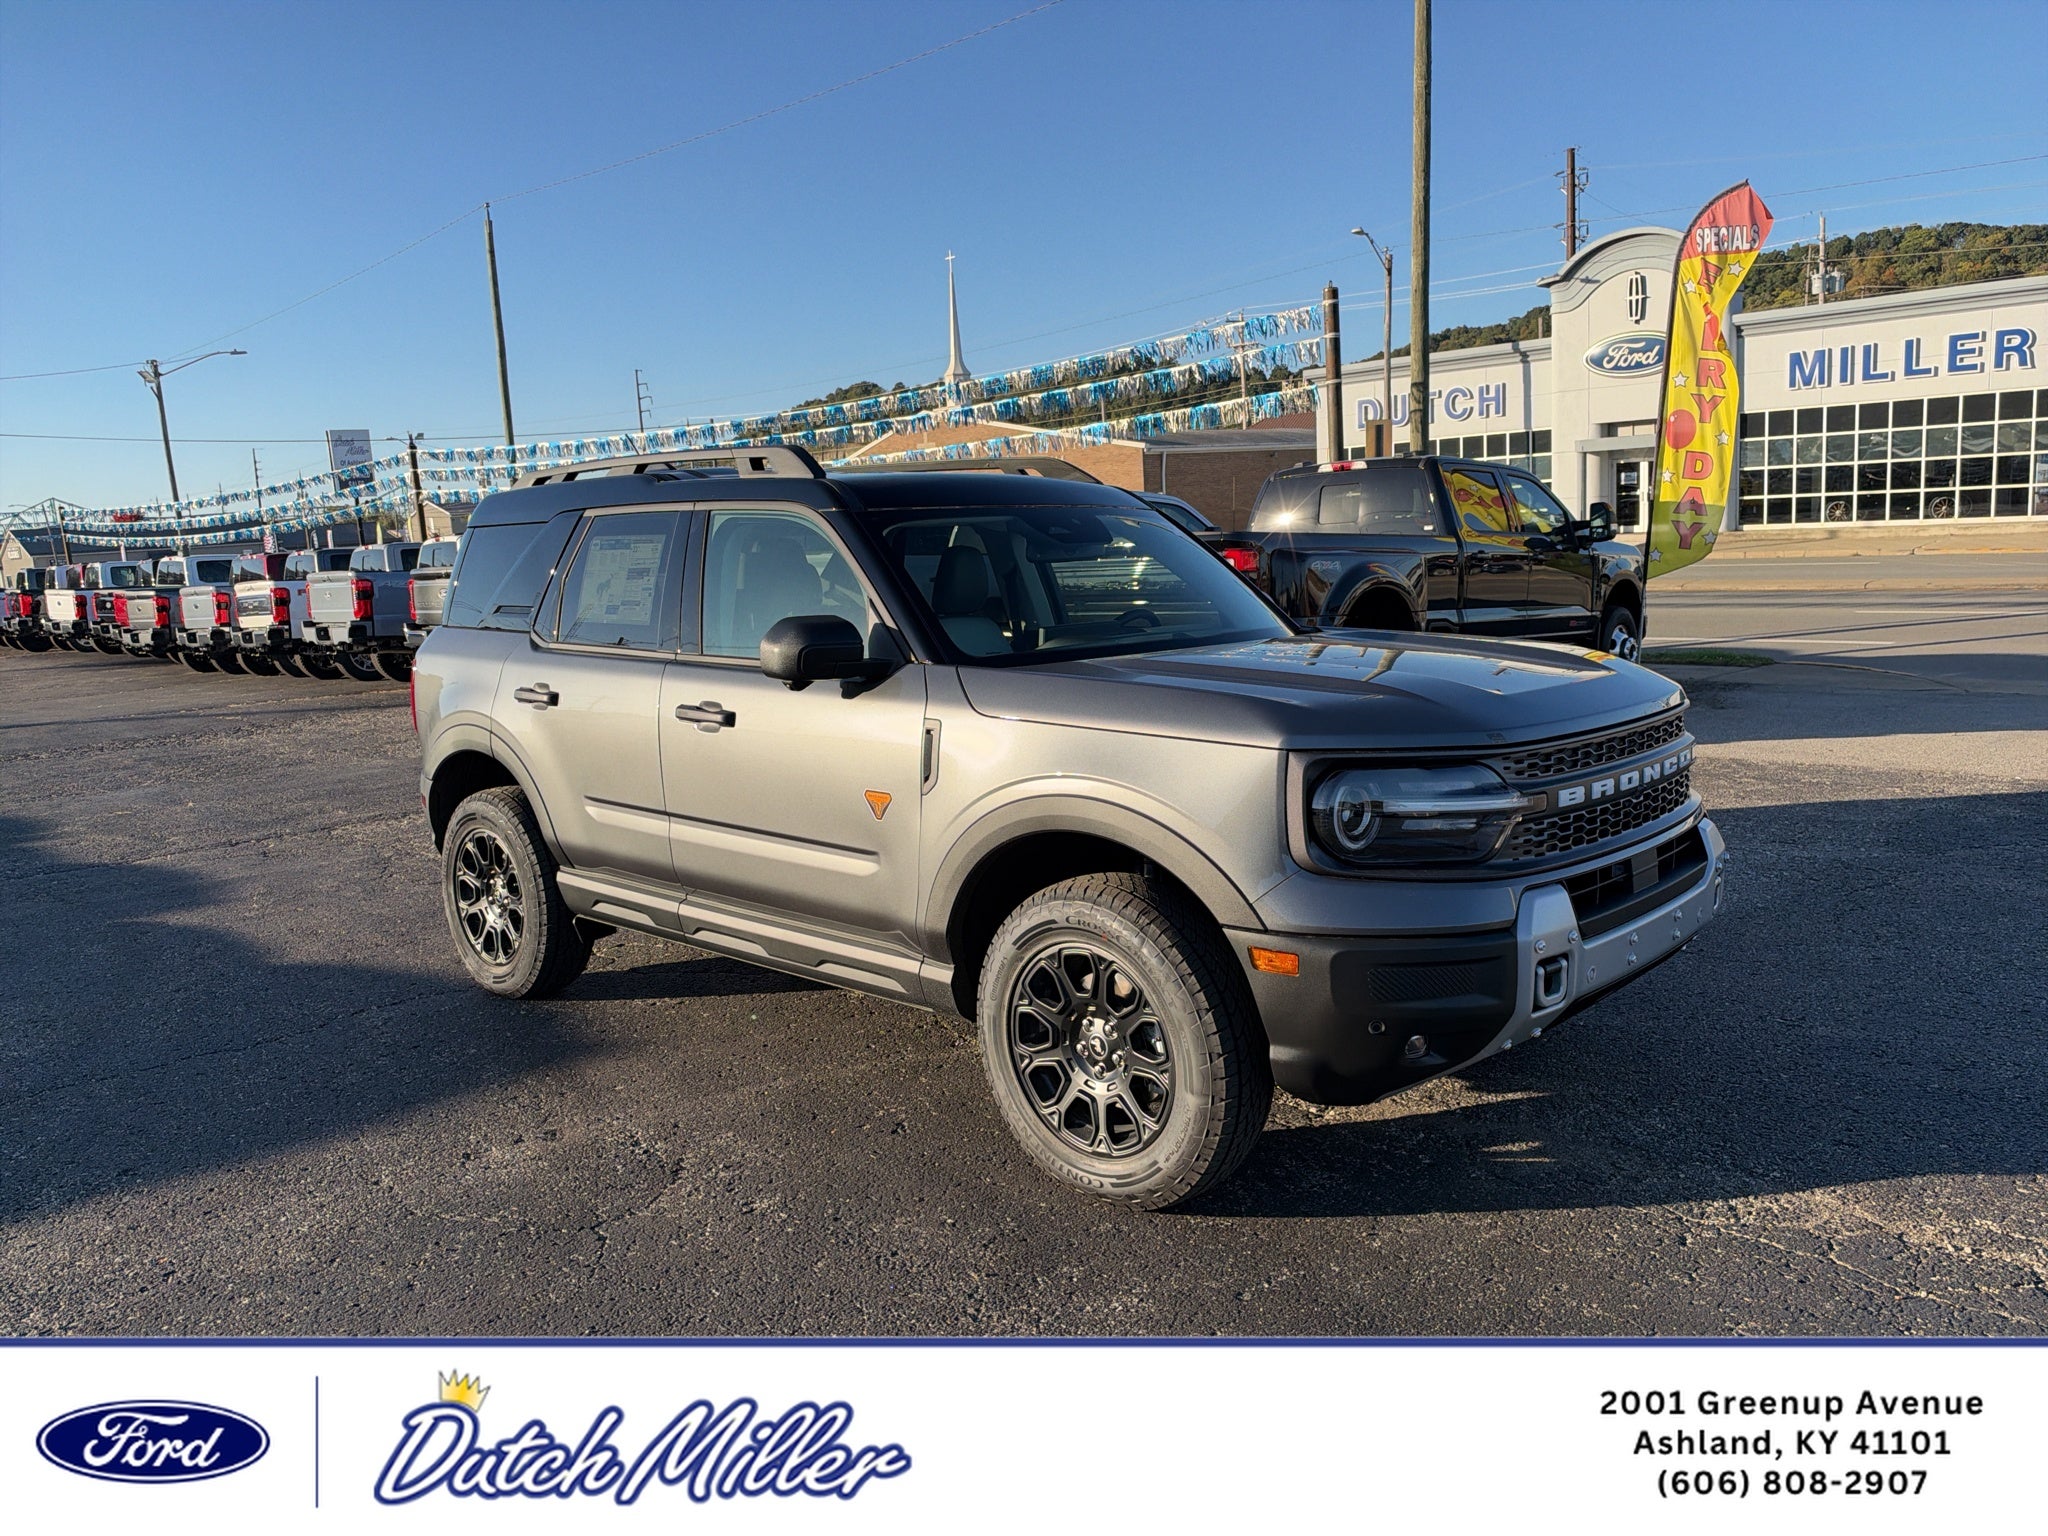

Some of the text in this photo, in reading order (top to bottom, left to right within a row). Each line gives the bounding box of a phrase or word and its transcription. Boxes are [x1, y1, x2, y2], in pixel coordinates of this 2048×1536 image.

[1695, 224, 1760, 253] SPECIALS
[1602, 341, 1661, 369] Ford
[1788, 328, 2035, 390] MILLER
[1671, 450, 1714, 550] DAY
[1557, 749, 1692, 808] BRONCO
